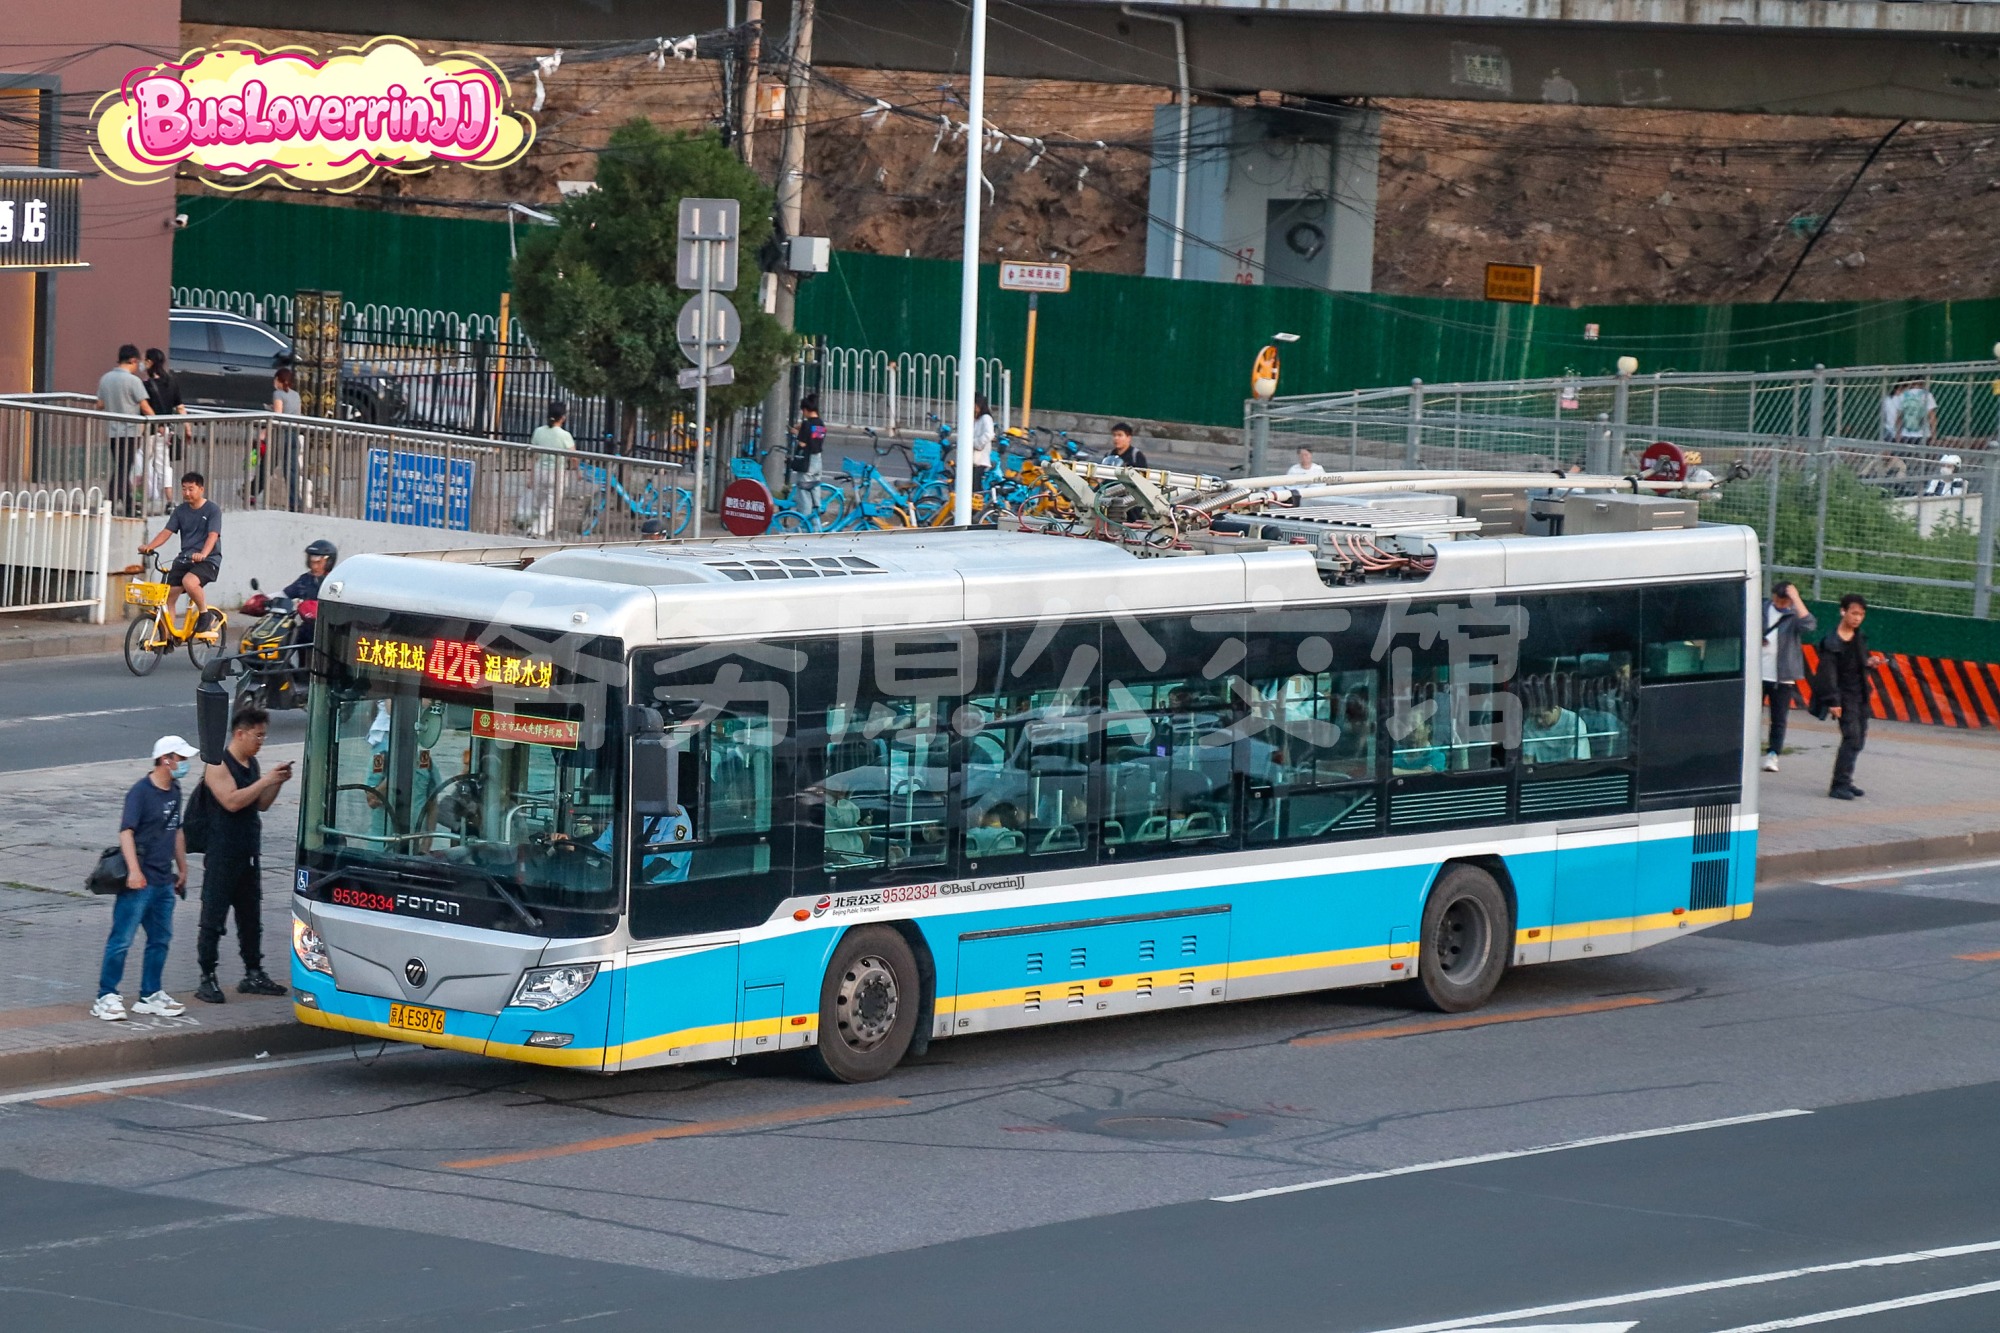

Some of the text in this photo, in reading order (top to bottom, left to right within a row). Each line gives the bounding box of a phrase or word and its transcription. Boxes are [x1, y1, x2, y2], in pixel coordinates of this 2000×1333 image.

[357, 637, 426, 672] 立水桥北站
[429, 640, 482, 684] 426
[333, 888, 460, 916] 9532334 FOTON
[834, 884, 937, 908] 北京公交 9532334
[860, 905, 880, 913] Transport
